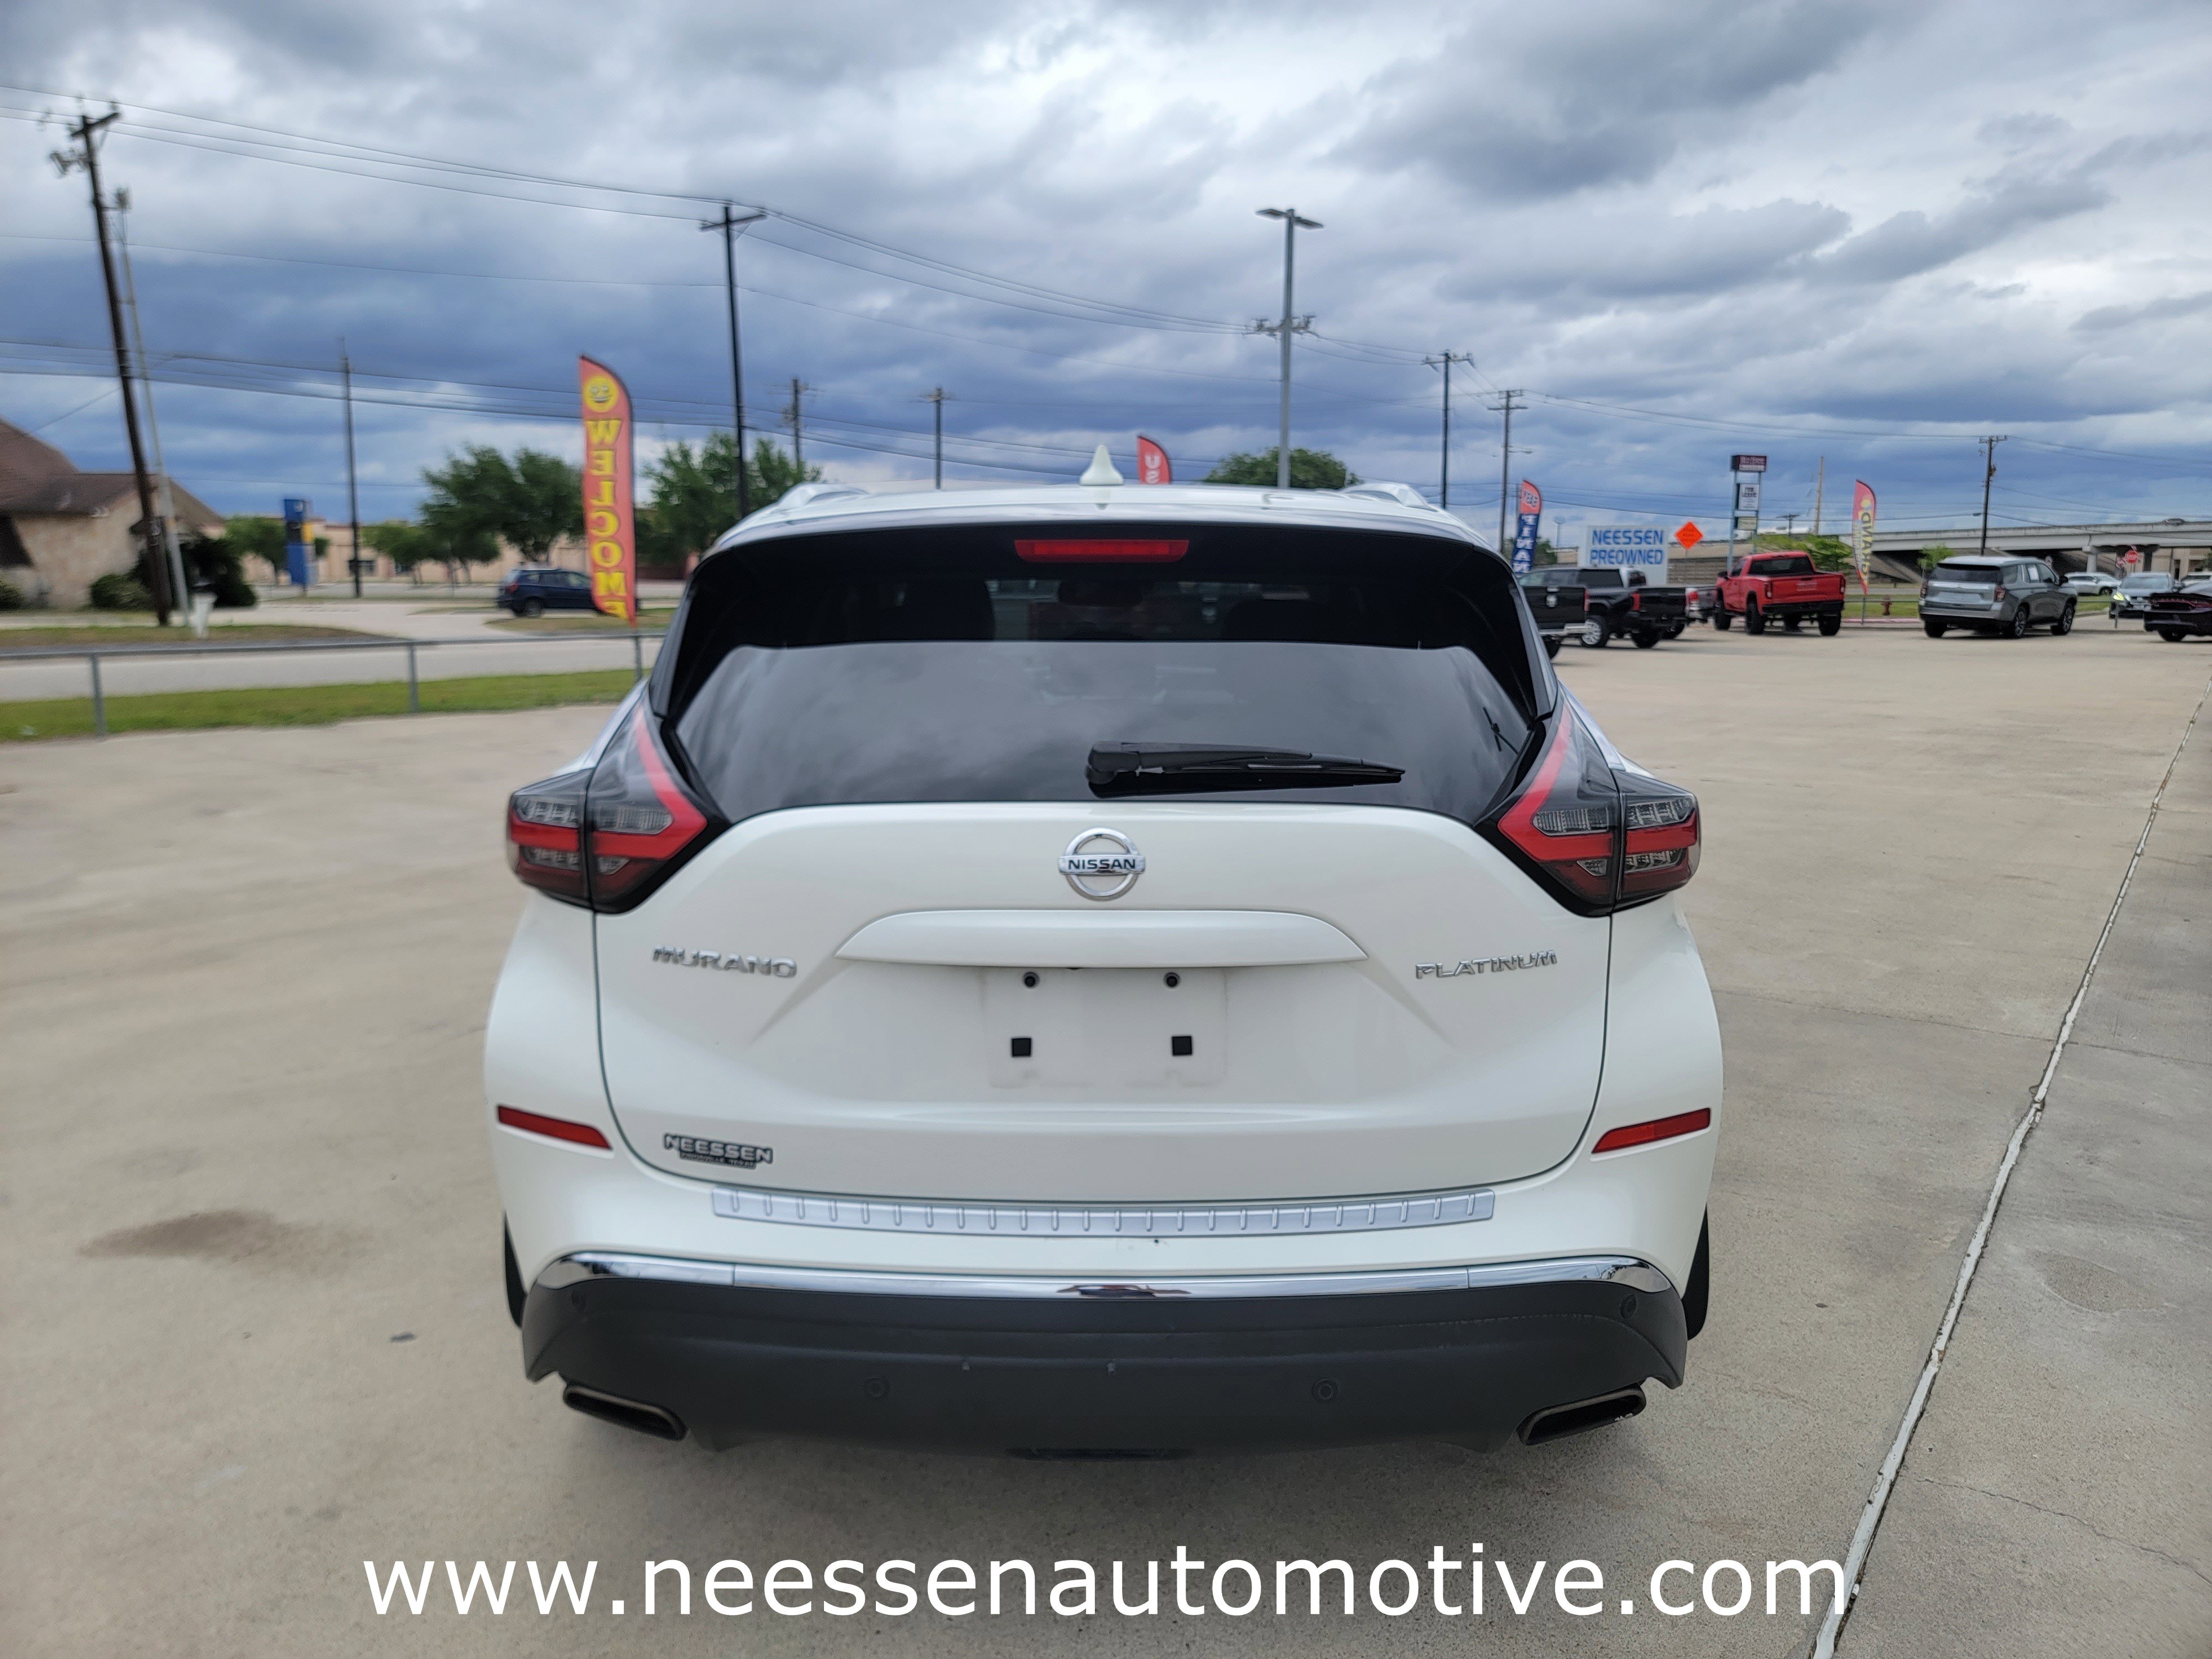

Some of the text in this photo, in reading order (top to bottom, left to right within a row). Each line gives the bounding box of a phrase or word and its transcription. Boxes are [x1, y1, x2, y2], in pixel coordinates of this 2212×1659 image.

[1592, 530, 1664, 545] NEESSEN
[1589, 549, 1664, 565] PREOWNED
[1068, 859, 1135, 870] NISSAN
[652, 944, 797, 978] MURANO
[1415, 949, 1558, 979] PLATINUM
[664, 1134, 773, 1164] NEESSEN
